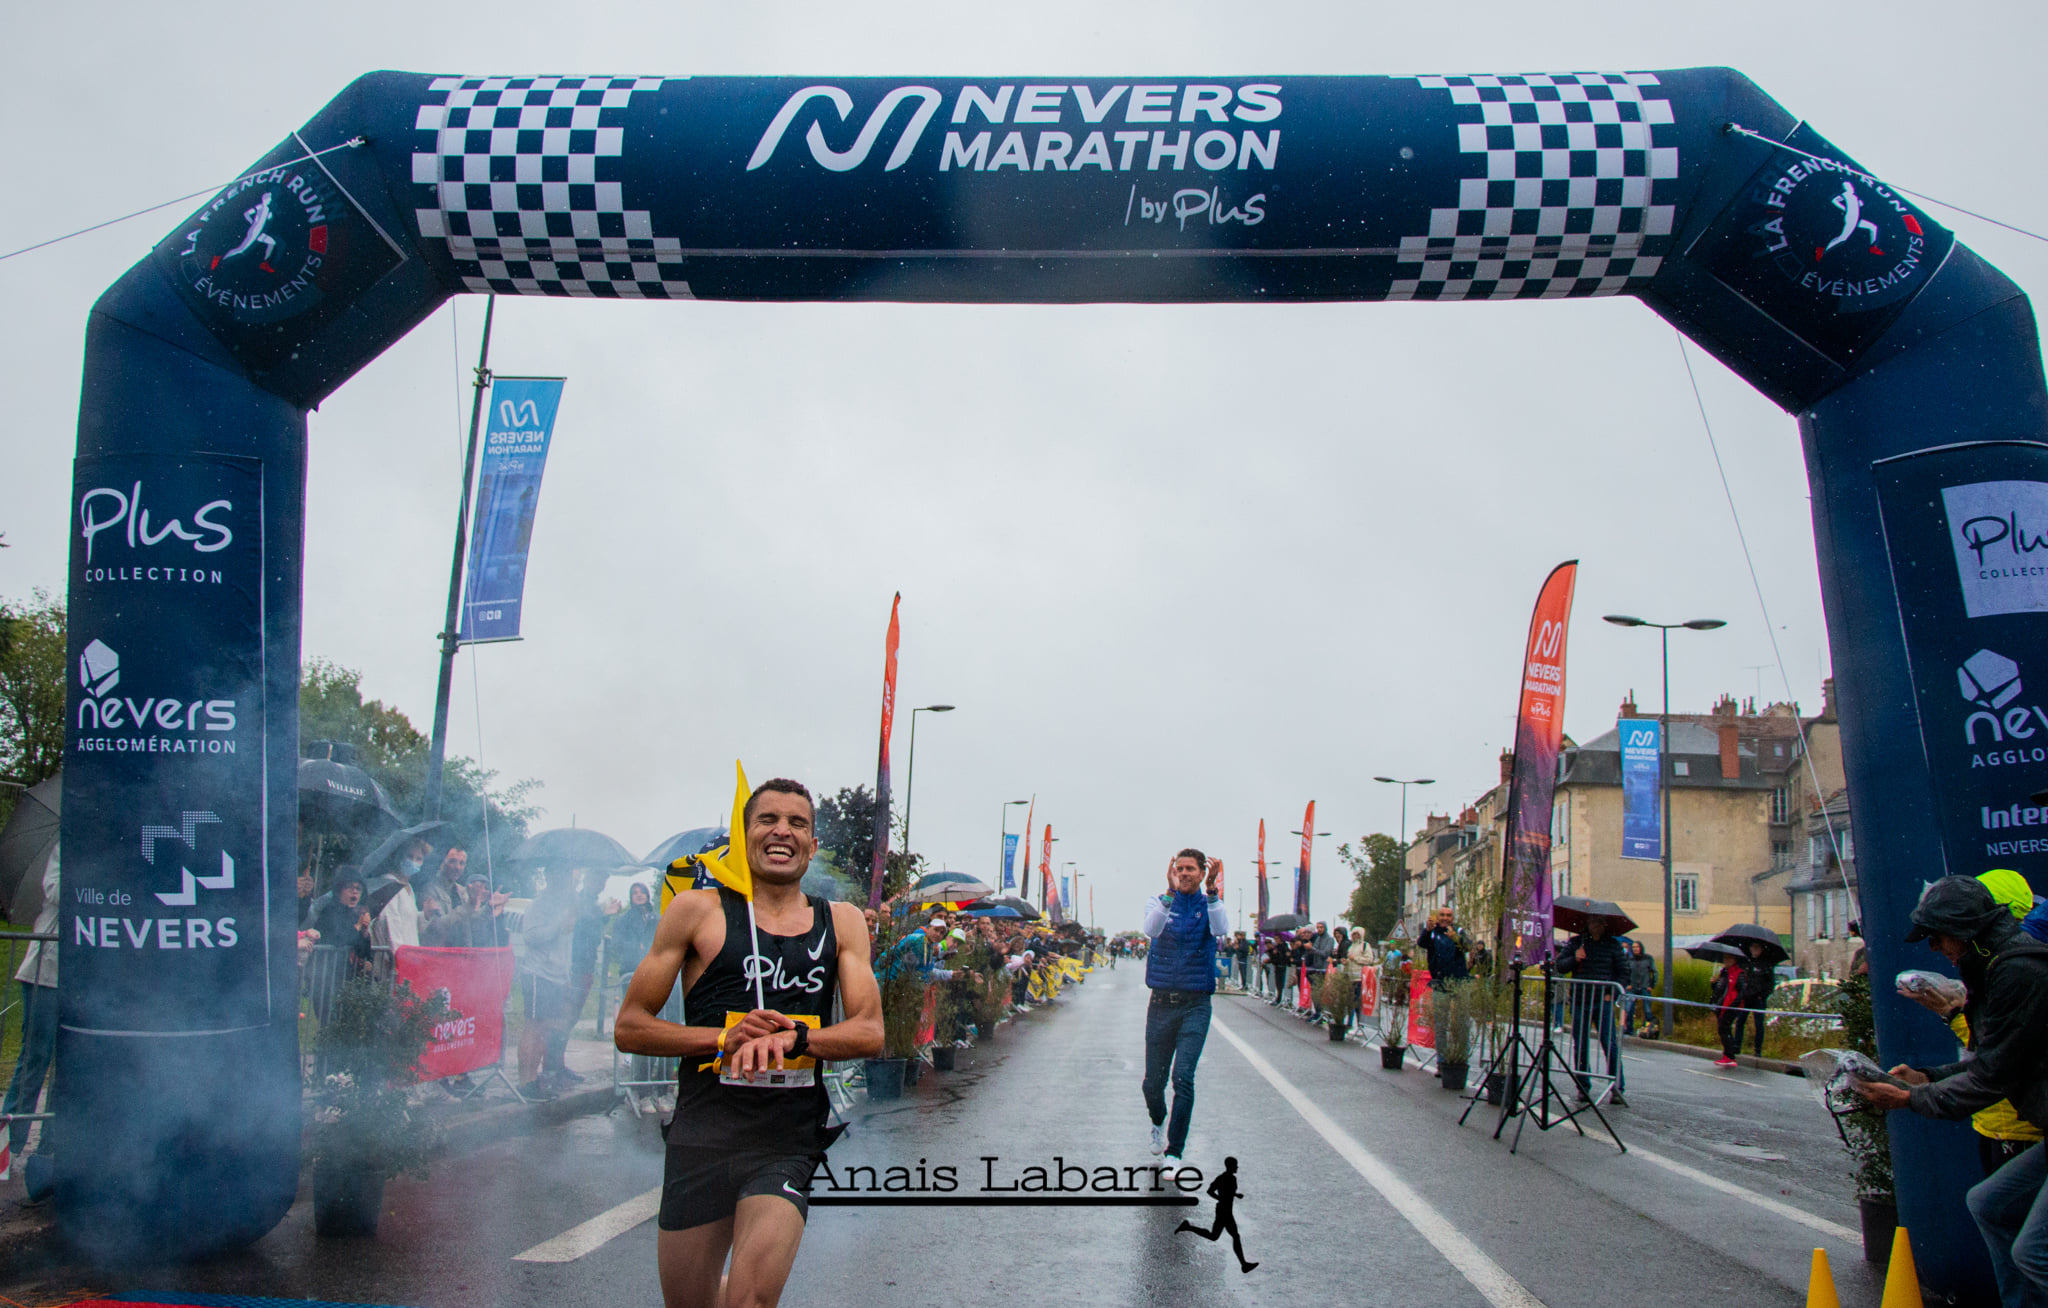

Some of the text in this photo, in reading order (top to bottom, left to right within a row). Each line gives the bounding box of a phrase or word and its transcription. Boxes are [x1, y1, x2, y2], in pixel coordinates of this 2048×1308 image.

[951, 84, 1282, 123] NEVERS
[939, 130, 1281, 171] MARATHON
[180, 169, 326, 256] LA FRENCH RUN
[1141, 185, 1266, 232] by Plus
[1764, 157, 1907, 252] LA FRENCH RUN
[194, 254, 322, 309] ÉVÉNEMENTS
[1801, 235, 1924, 296] ÉVÉNEMENTS
[80, 480, 233, 565] Plus
[1961, 510, 2048, 568] Plu
[85, 567, 222, 584] COLLECTION
[1525, 680, 1560, 696] MARATHON
[1528, 662, 1560, 682] NEVERS
[78, 697, 236, 730] nevers
[78, 735, 236, 753] AGGLOMÉRATION
[1972, 747, 2048, 768] AGGLO
[1986, 838, 2048, 857] NEVERS
[75, 887, 132, 906] Ville de
[75, 915, 239, 949] NEVERS
[743, 954, 826, 993] Plus
[434, 1017, 475, 1040] nevers
